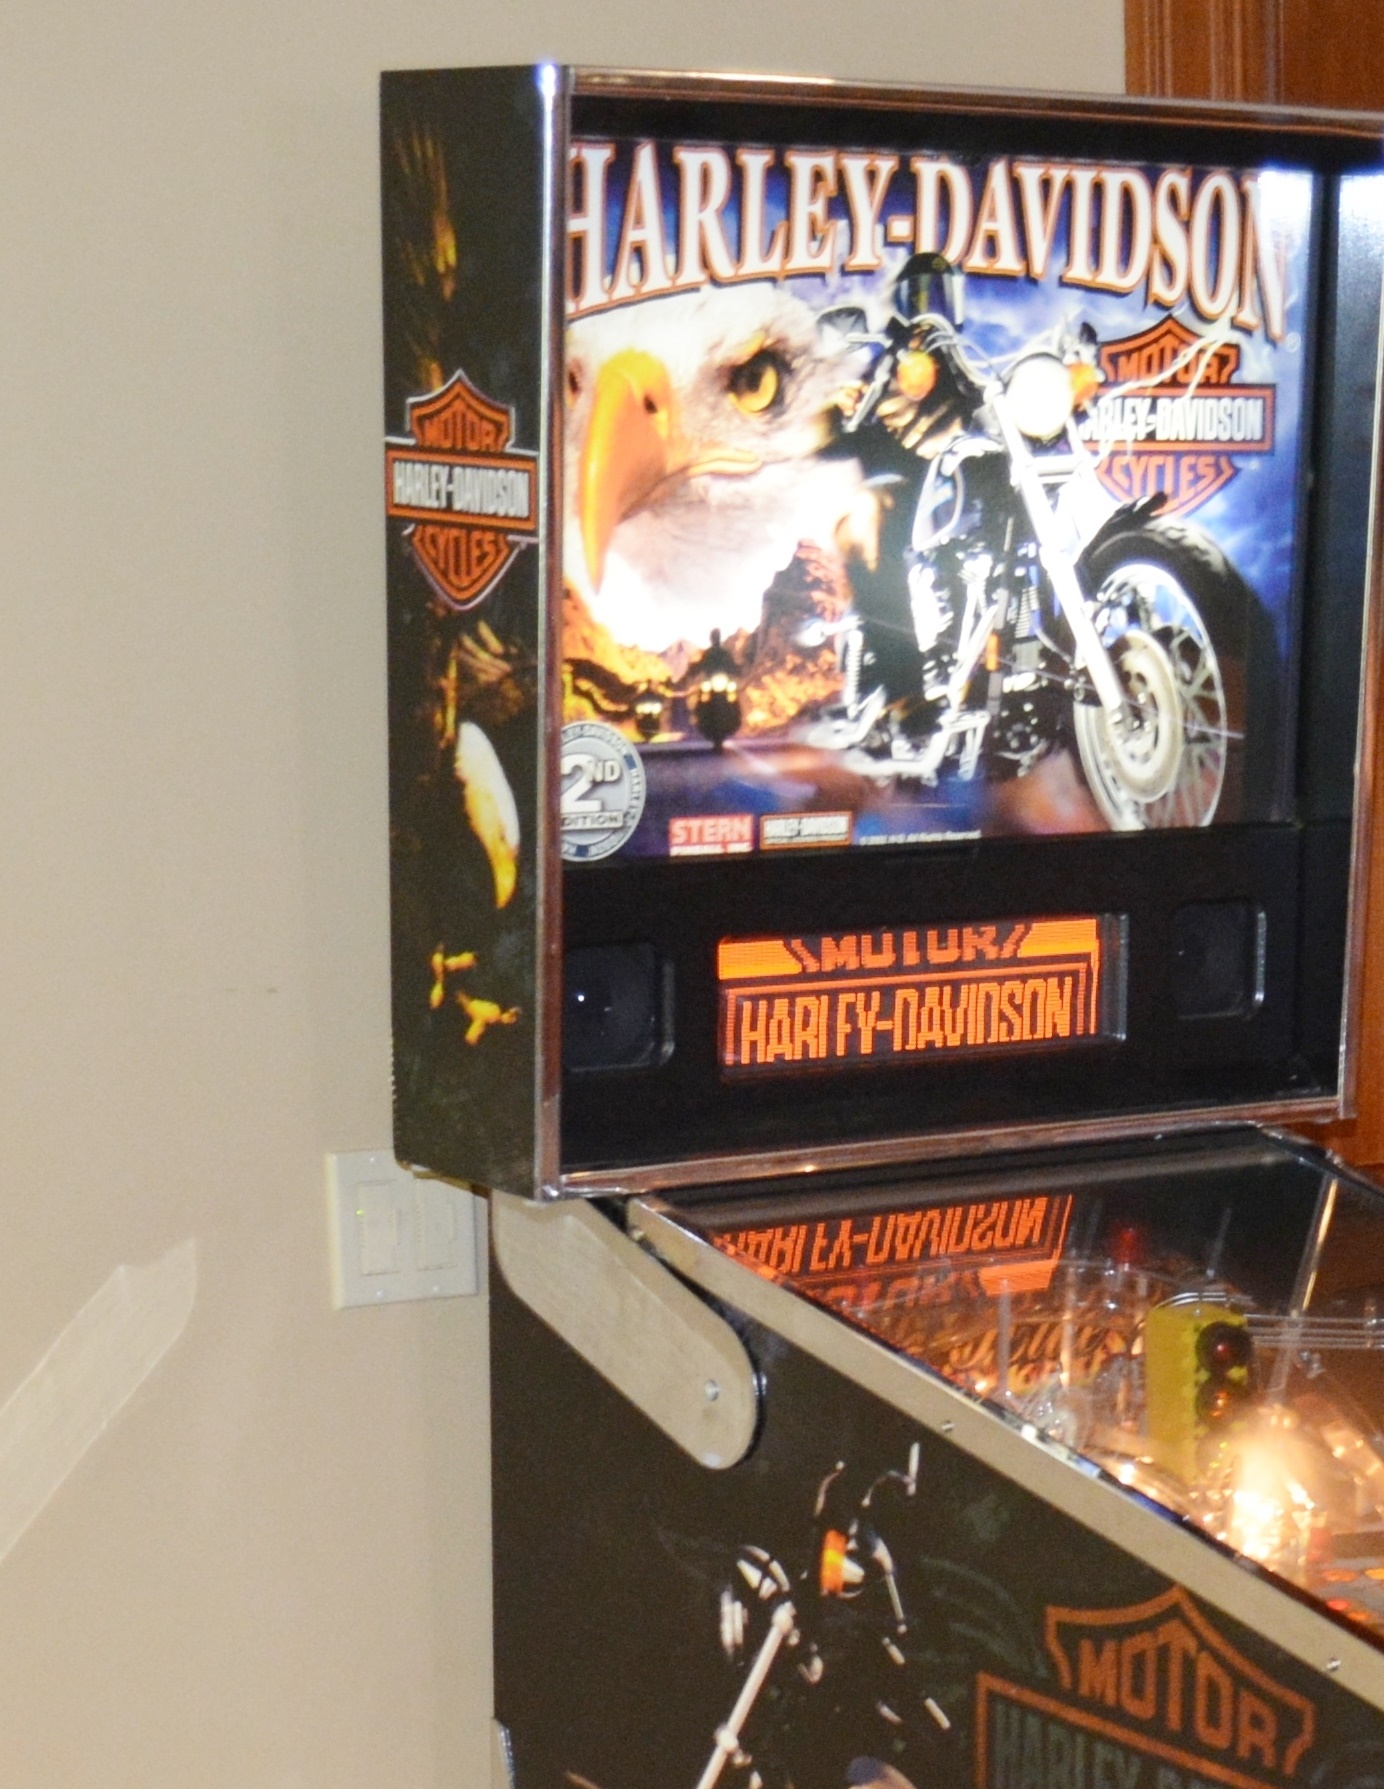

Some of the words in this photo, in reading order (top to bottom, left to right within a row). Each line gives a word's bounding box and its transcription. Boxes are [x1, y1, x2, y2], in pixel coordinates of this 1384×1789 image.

[562, 814, 620, 830] DITION
[672, 819, 752, 845] STERN
[1078, 1619, 1279, 1769] MOTOR
